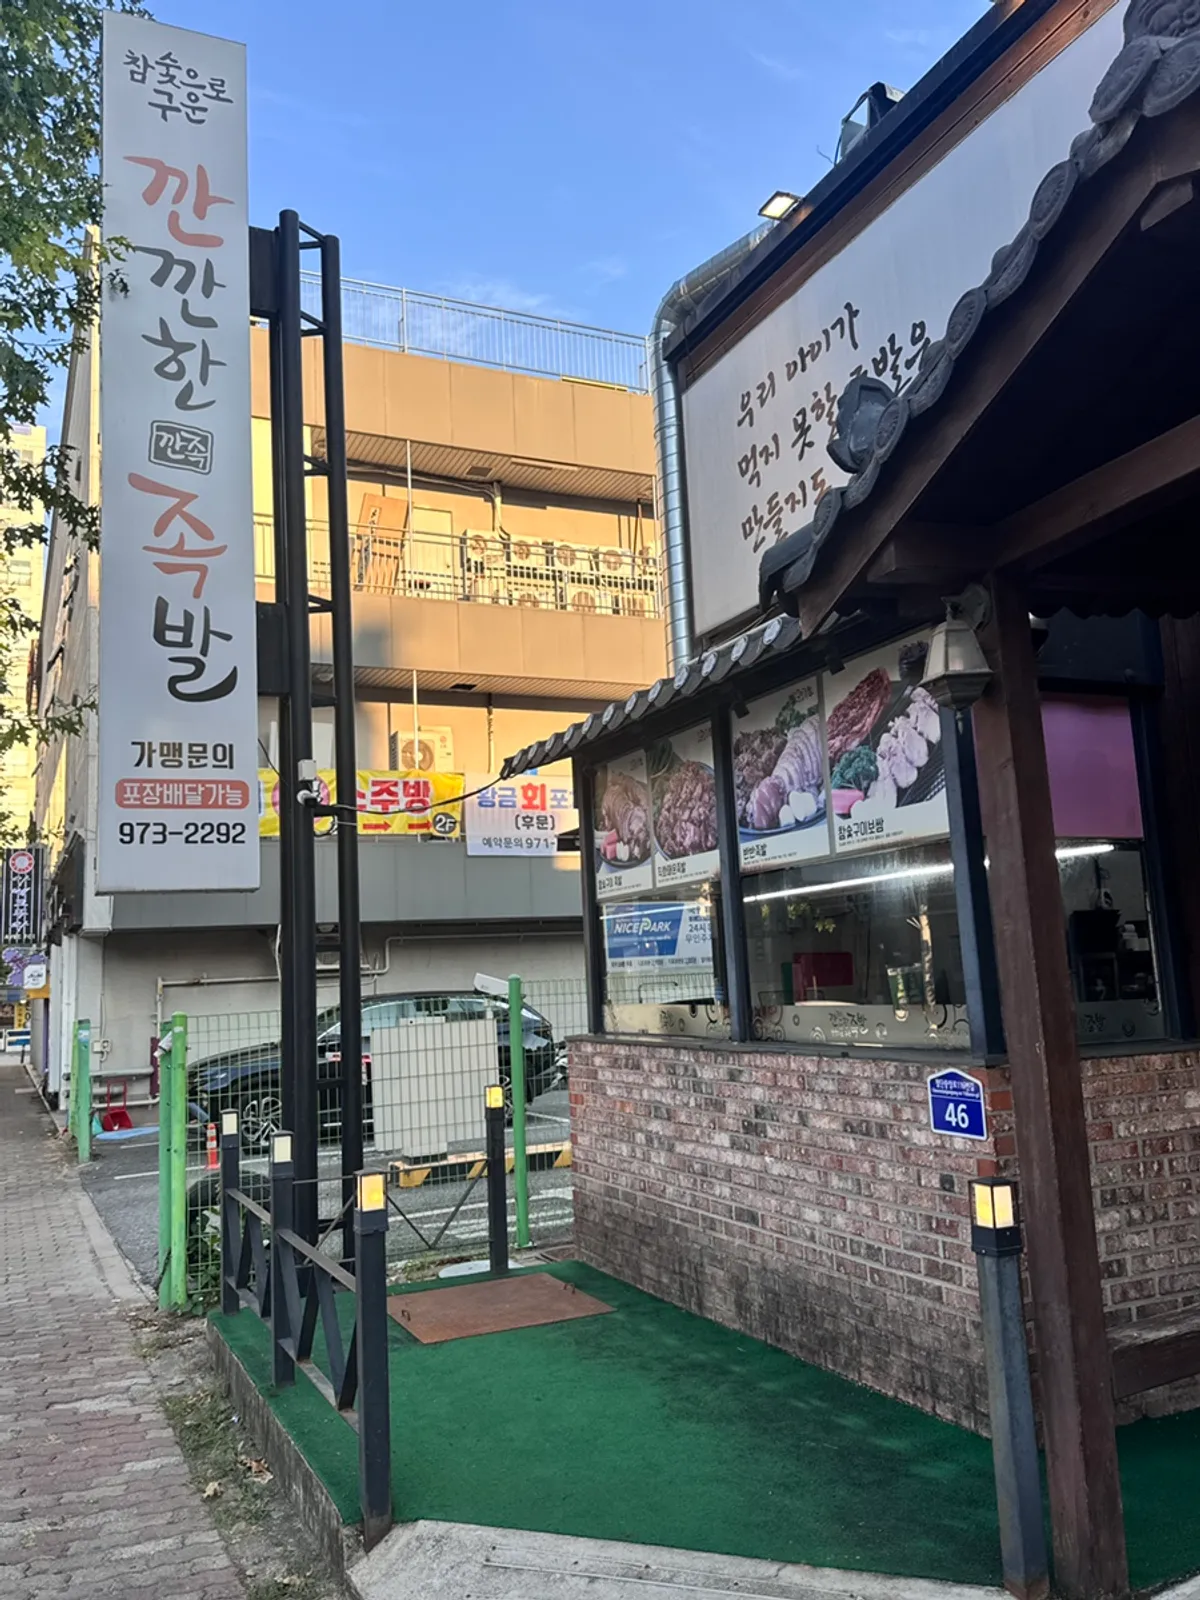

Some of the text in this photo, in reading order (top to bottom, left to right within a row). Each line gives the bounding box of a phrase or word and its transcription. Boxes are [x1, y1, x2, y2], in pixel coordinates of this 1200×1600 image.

[123, 49, 234, 103] 참숯으로
[148, 88, 208, 125] 구운
[737, 371, 776, 428] 우리
[737, 433, 780, 488] 먹지
[127, 472, 233, 702] 족발
[131, 742, 234, 769] 가맹문의
[123, 782, 243, 806] 포장배달가능
[118, 822, 246, 845] 973-2292
[435, 815, 456, 832] 2F
[944, 1102, 970, 1129] 46
